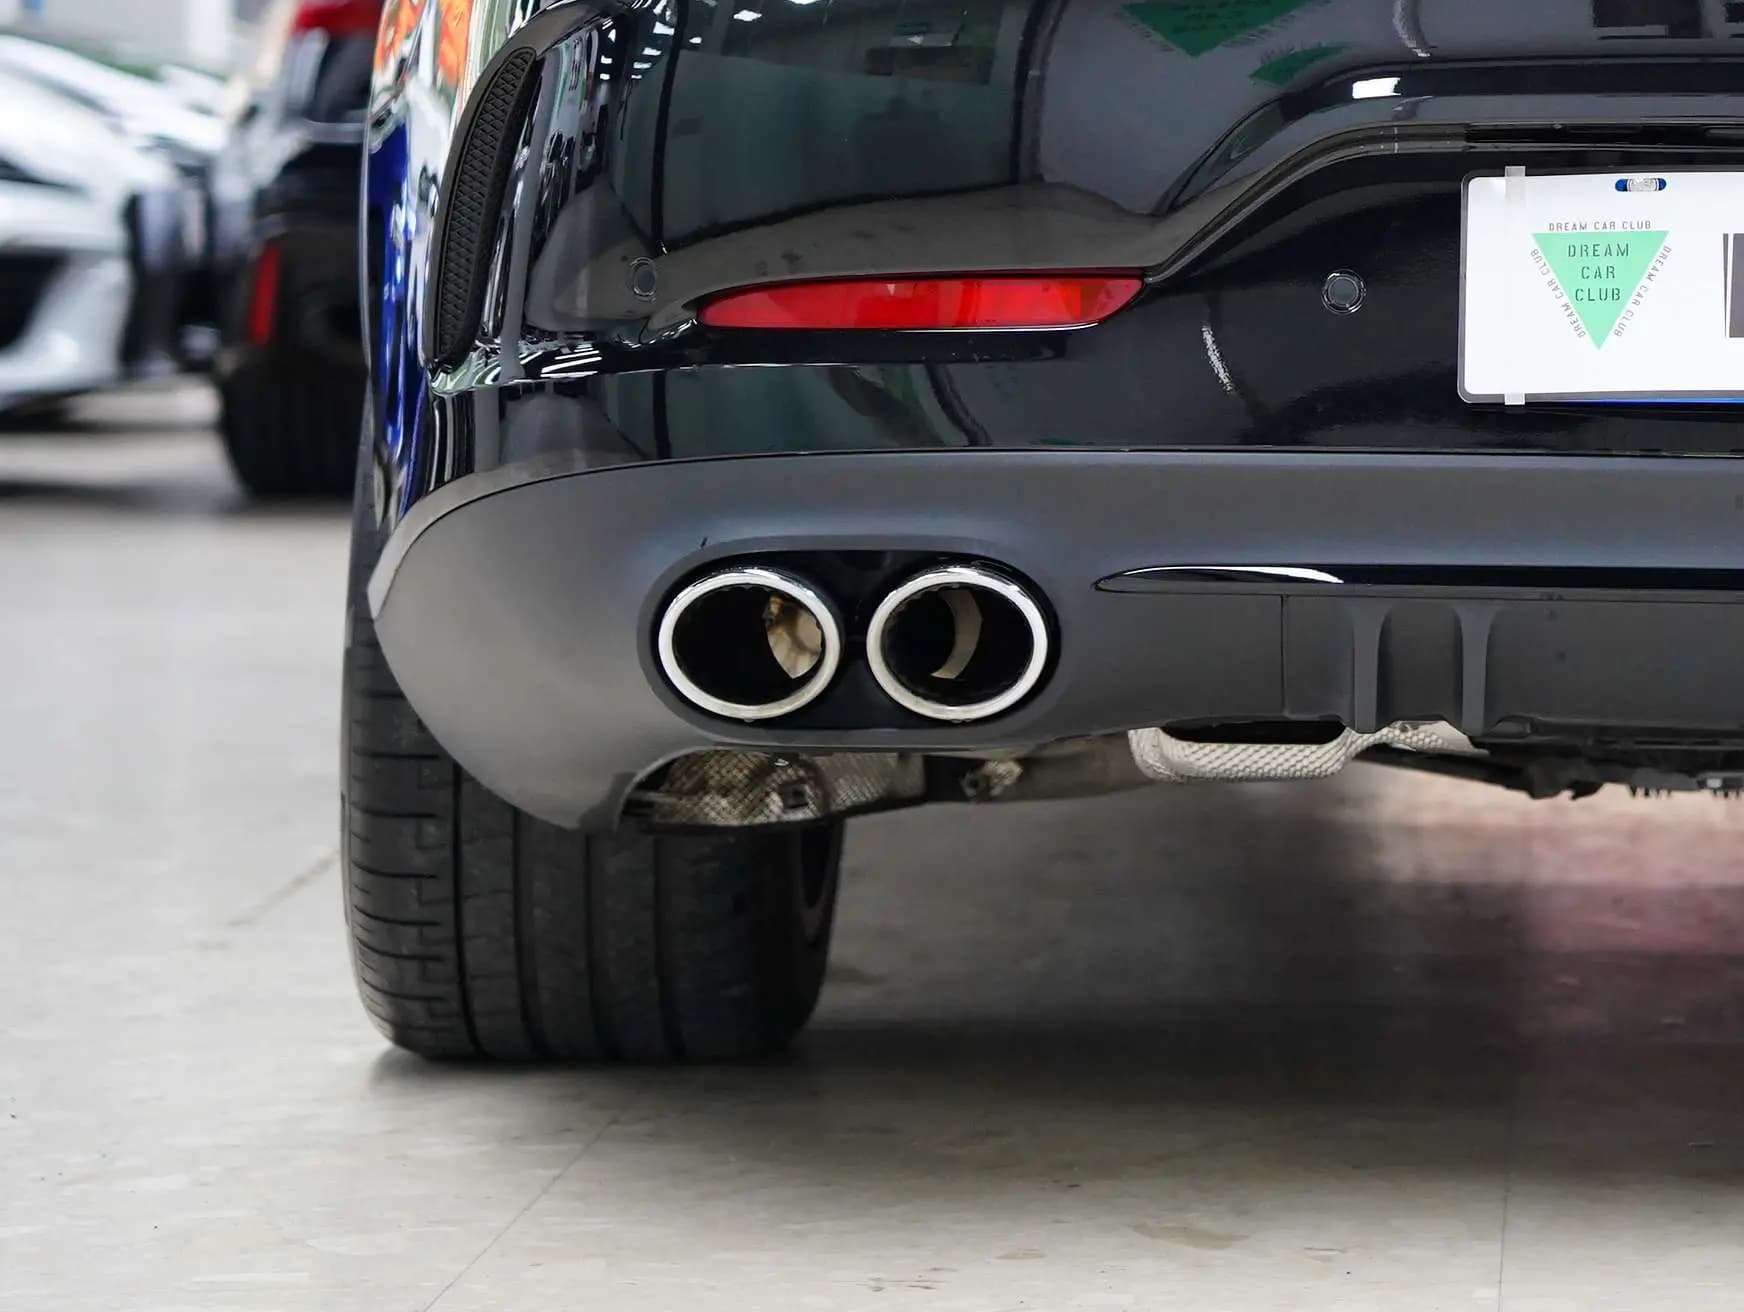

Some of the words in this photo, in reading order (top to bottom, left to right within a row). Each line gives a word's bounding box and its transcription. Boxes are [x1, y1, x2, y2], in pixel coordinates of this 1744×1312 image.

[1548, 222, 1588, 232] DREAM
[1593, 221, 1616, 230] CAR
[1621, 220, 1652, 230] CLUB
[1567, 243, 1630, 258] DREAM
[1530, 248, 1550, 276] CLUB
[1580, 265, 1616, 280] CAR
[1646, 245, 1672, 282] DREAM
[1546, 278, 1564, 300] CAR
[1574, 287, 1621, 302] CLUB
[1631, 284, 1649, 307] CAR
[1561, 302, 1587, 338] DREAM
[1613, 309, 1635, 338] CLUB
